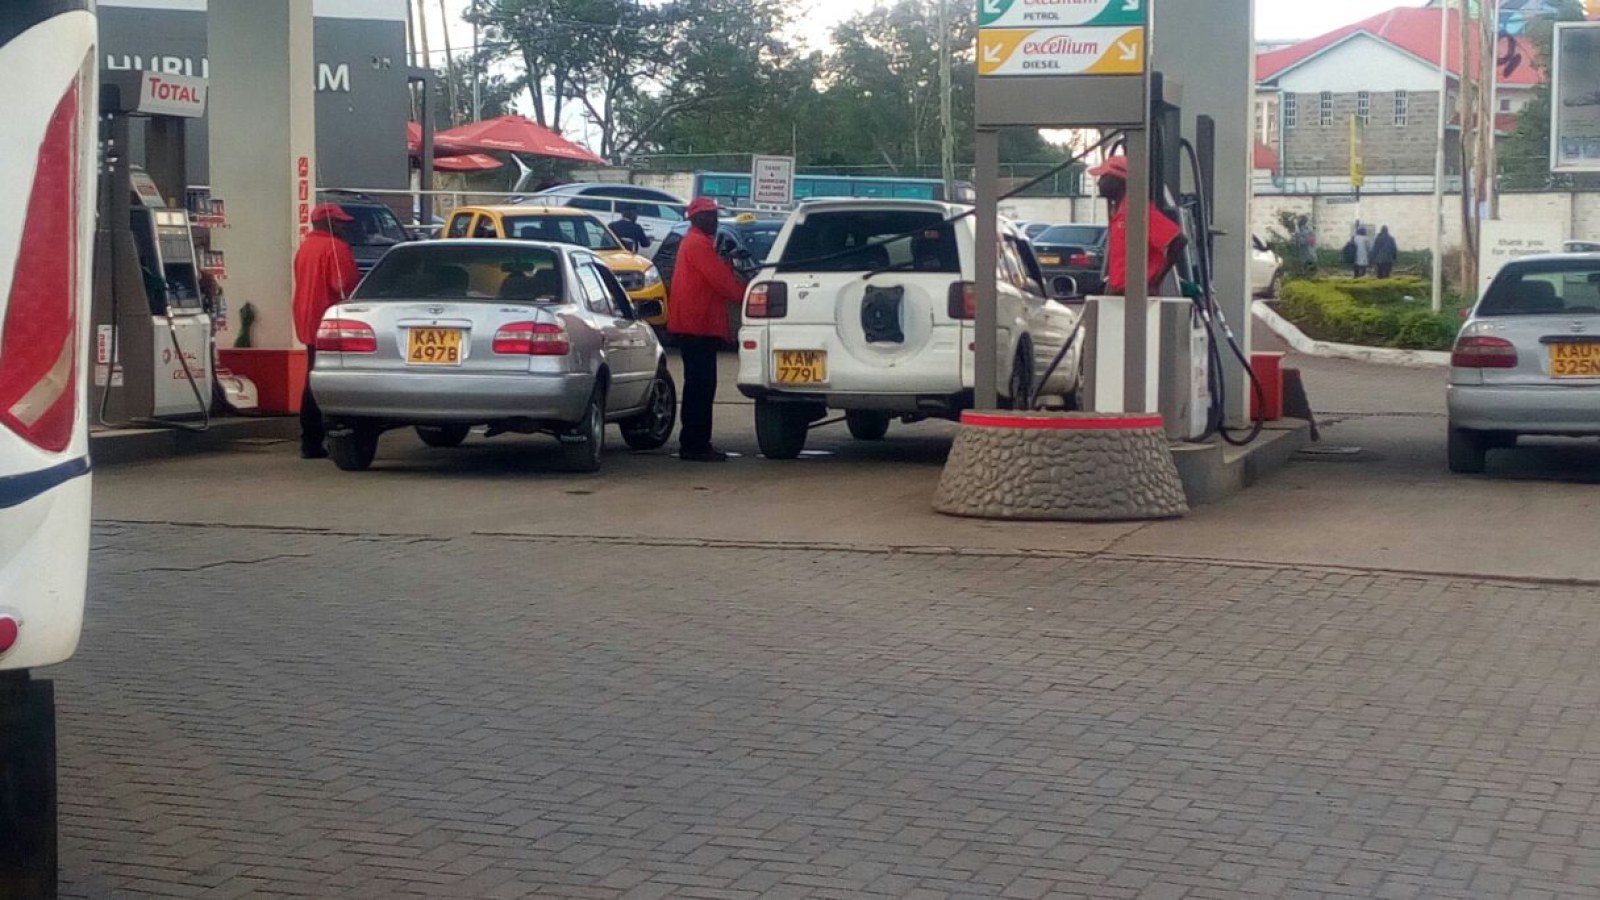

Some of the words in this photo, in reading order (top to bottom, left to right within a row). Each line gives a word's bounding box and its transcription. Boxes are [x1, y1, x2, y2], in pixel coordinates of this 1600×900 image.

[1023, 12, 1060, 20] PETROL
[1023, 36, 1098, 55] excellium
[1022, 60, 1061, 69] DIESEL
[148, 76, 200, 103] TOTAL
[1527, 240, 1544, 248] you
[415, 330, 446, 345] KAY
[1557, 343, 1592, 357] KAU
[782, 351, 814, 366] KAW
[779, 367, 821, 382] 779L
